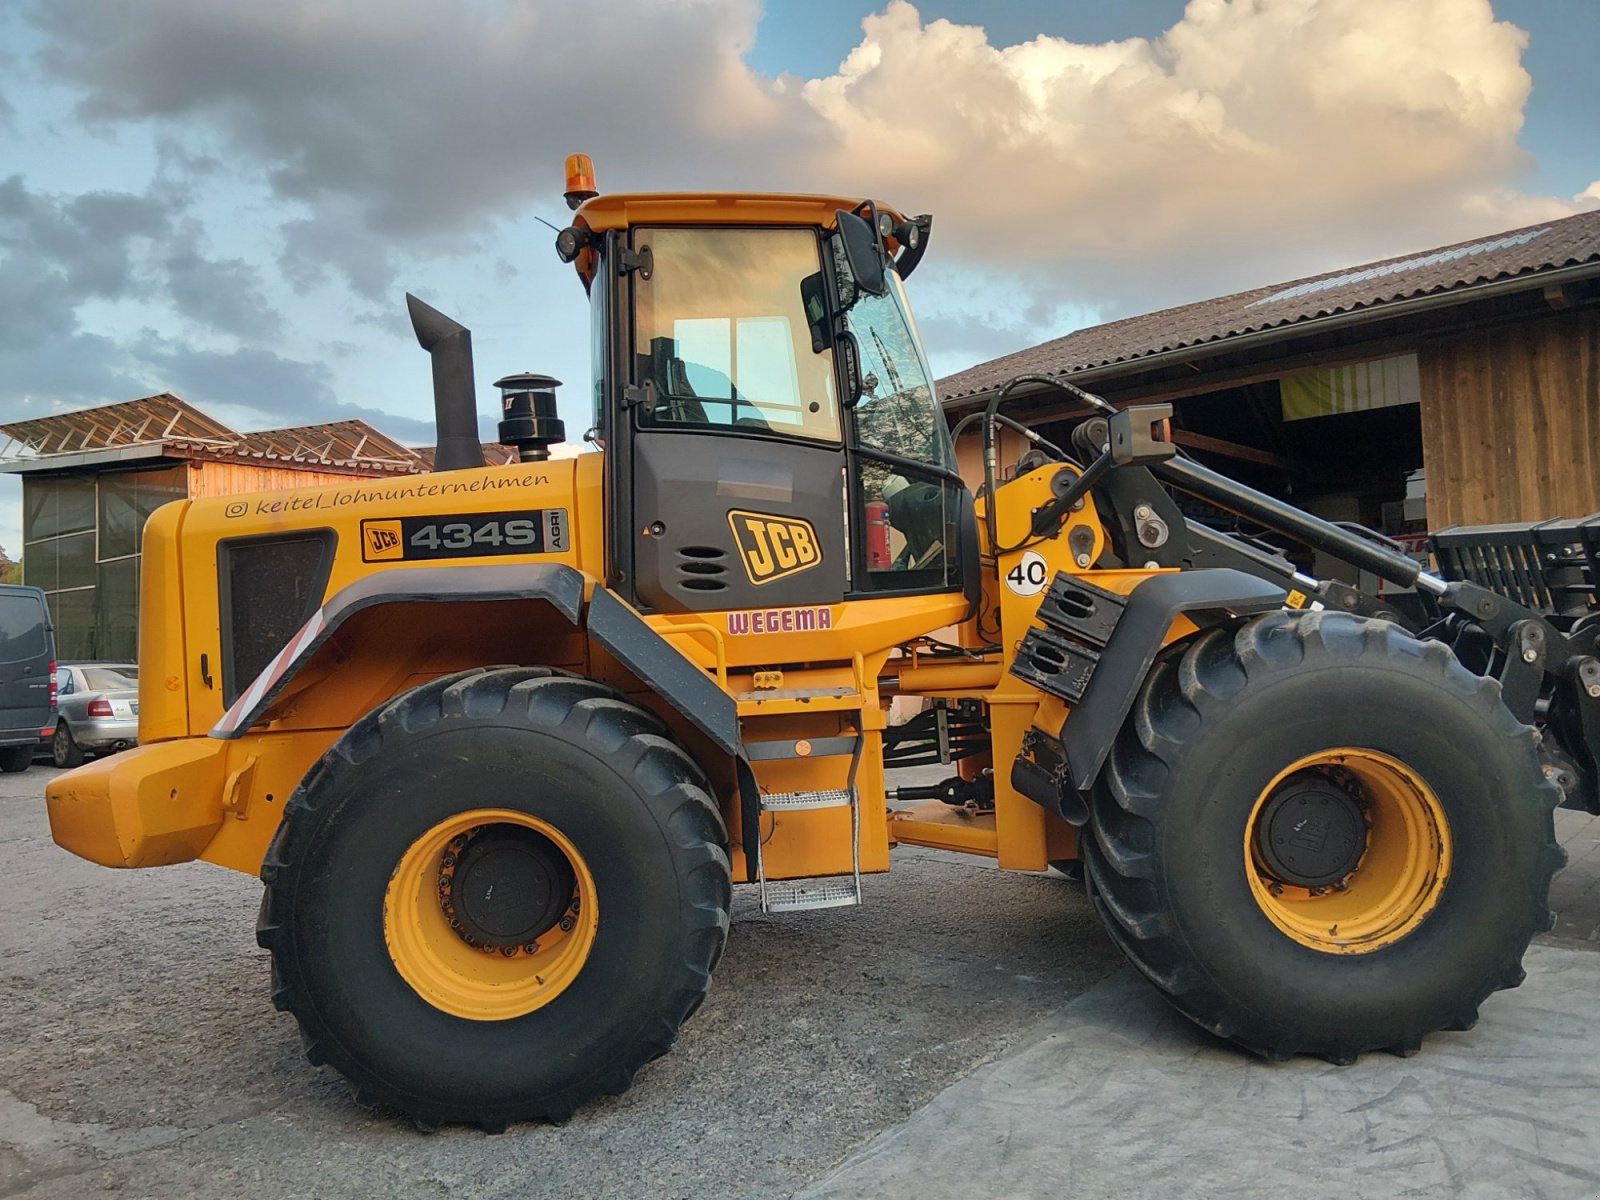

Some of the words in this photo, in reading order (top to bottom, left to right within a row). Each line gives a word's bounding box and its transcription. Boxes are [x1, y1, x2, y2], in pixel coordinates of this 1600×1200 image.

[255, 474, 550, 515] keitel_lohnunternehmen
[372, 531, 398, 550] JCB
[411, 520, 536, 550] 434S
[550, 511, 561, 549] AGRI
[745, 519, 815, 576] JCB
[1007, 560, 1046, 586] 40
[728, 608, 831, 635] WEGEMA
